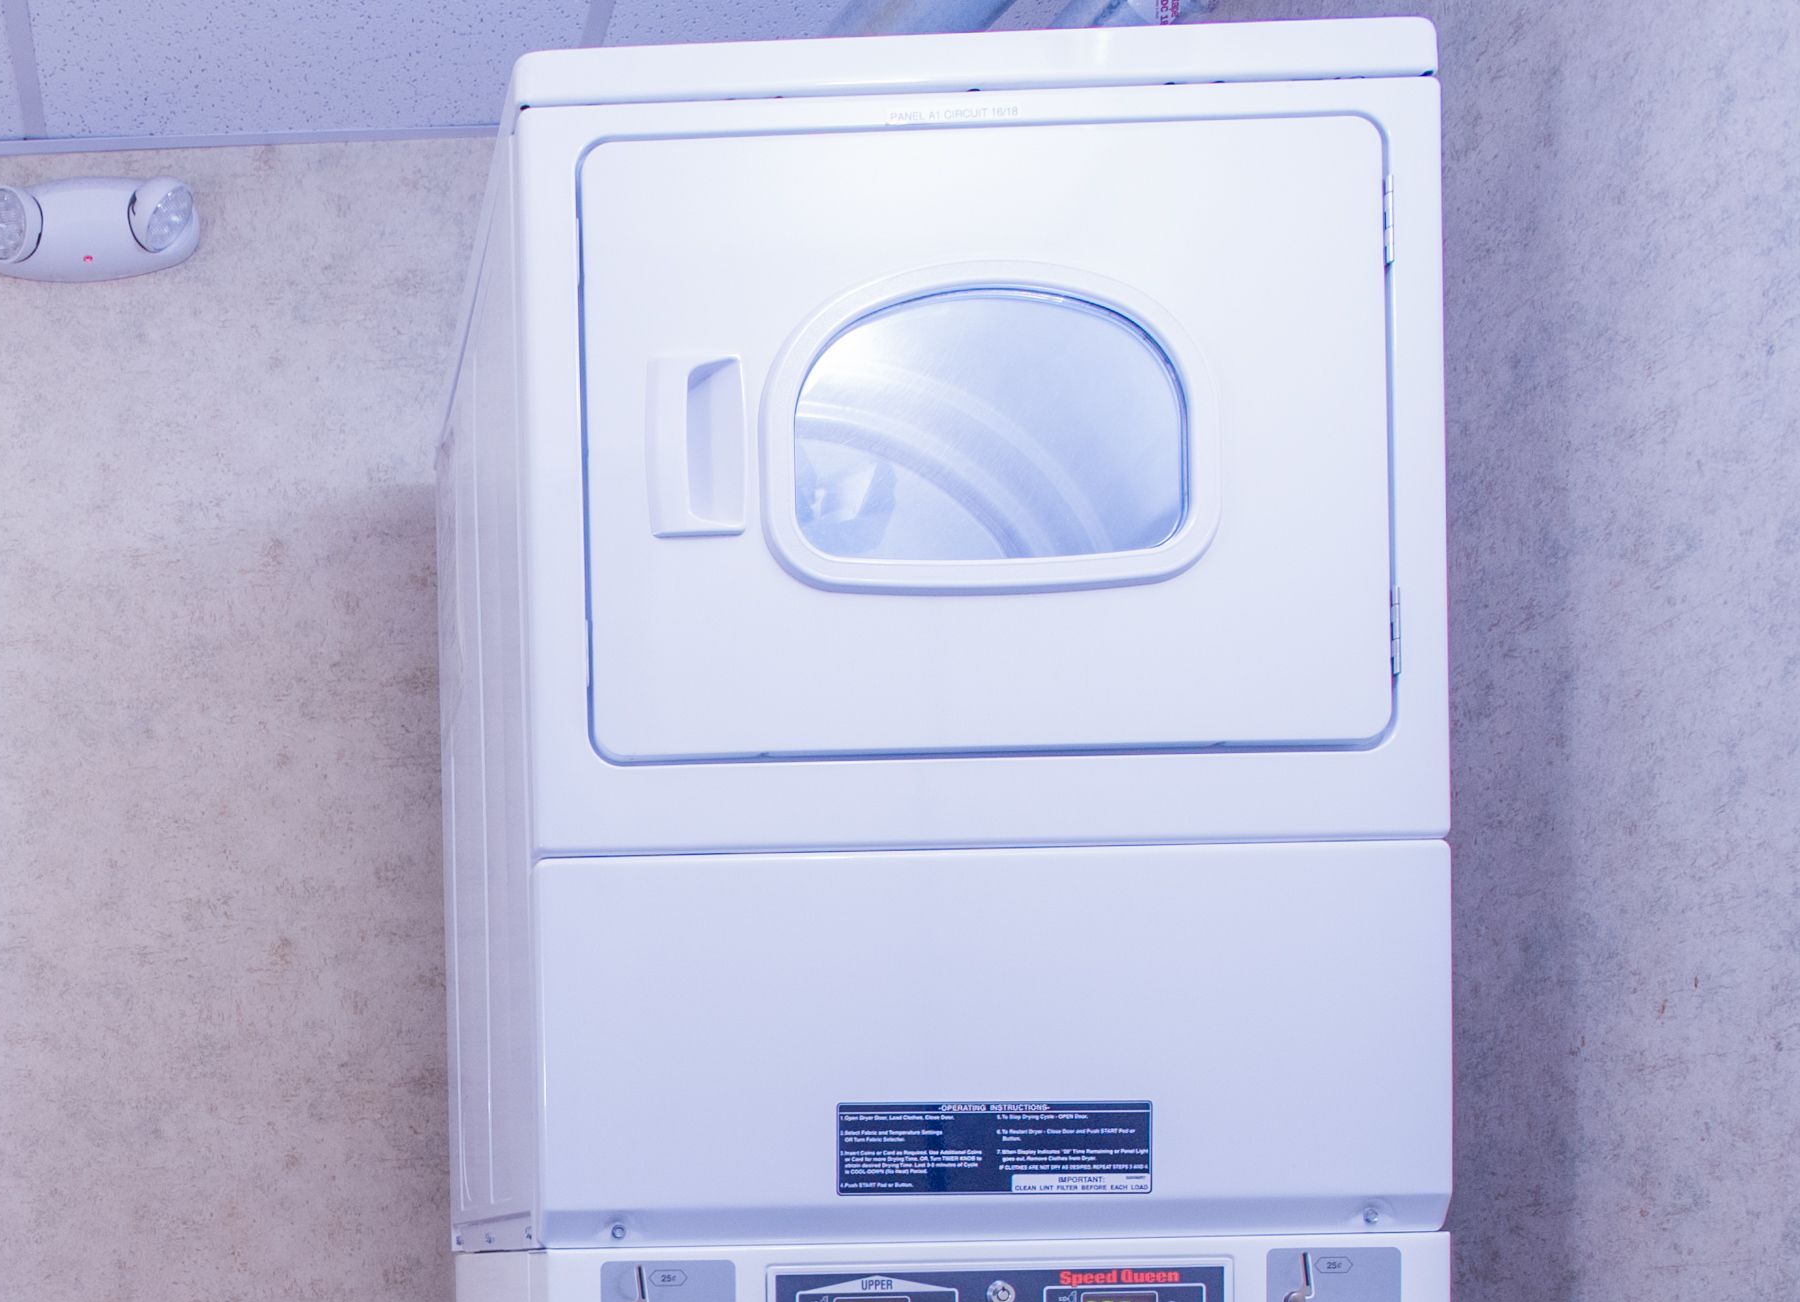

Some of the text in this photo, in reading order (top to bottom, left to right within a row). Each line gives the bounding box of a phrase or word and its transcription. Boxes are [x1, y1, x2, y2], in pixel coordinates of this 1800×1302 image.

[890, 111, 925, 121] PANEL
[928, 111, 940, 120] A1
[944, 108, 987, 119] CIRCUIT
[1059, 1268, 1180, 1288] Speed Queen
[861, 1279, 893, 1291] UPPER
